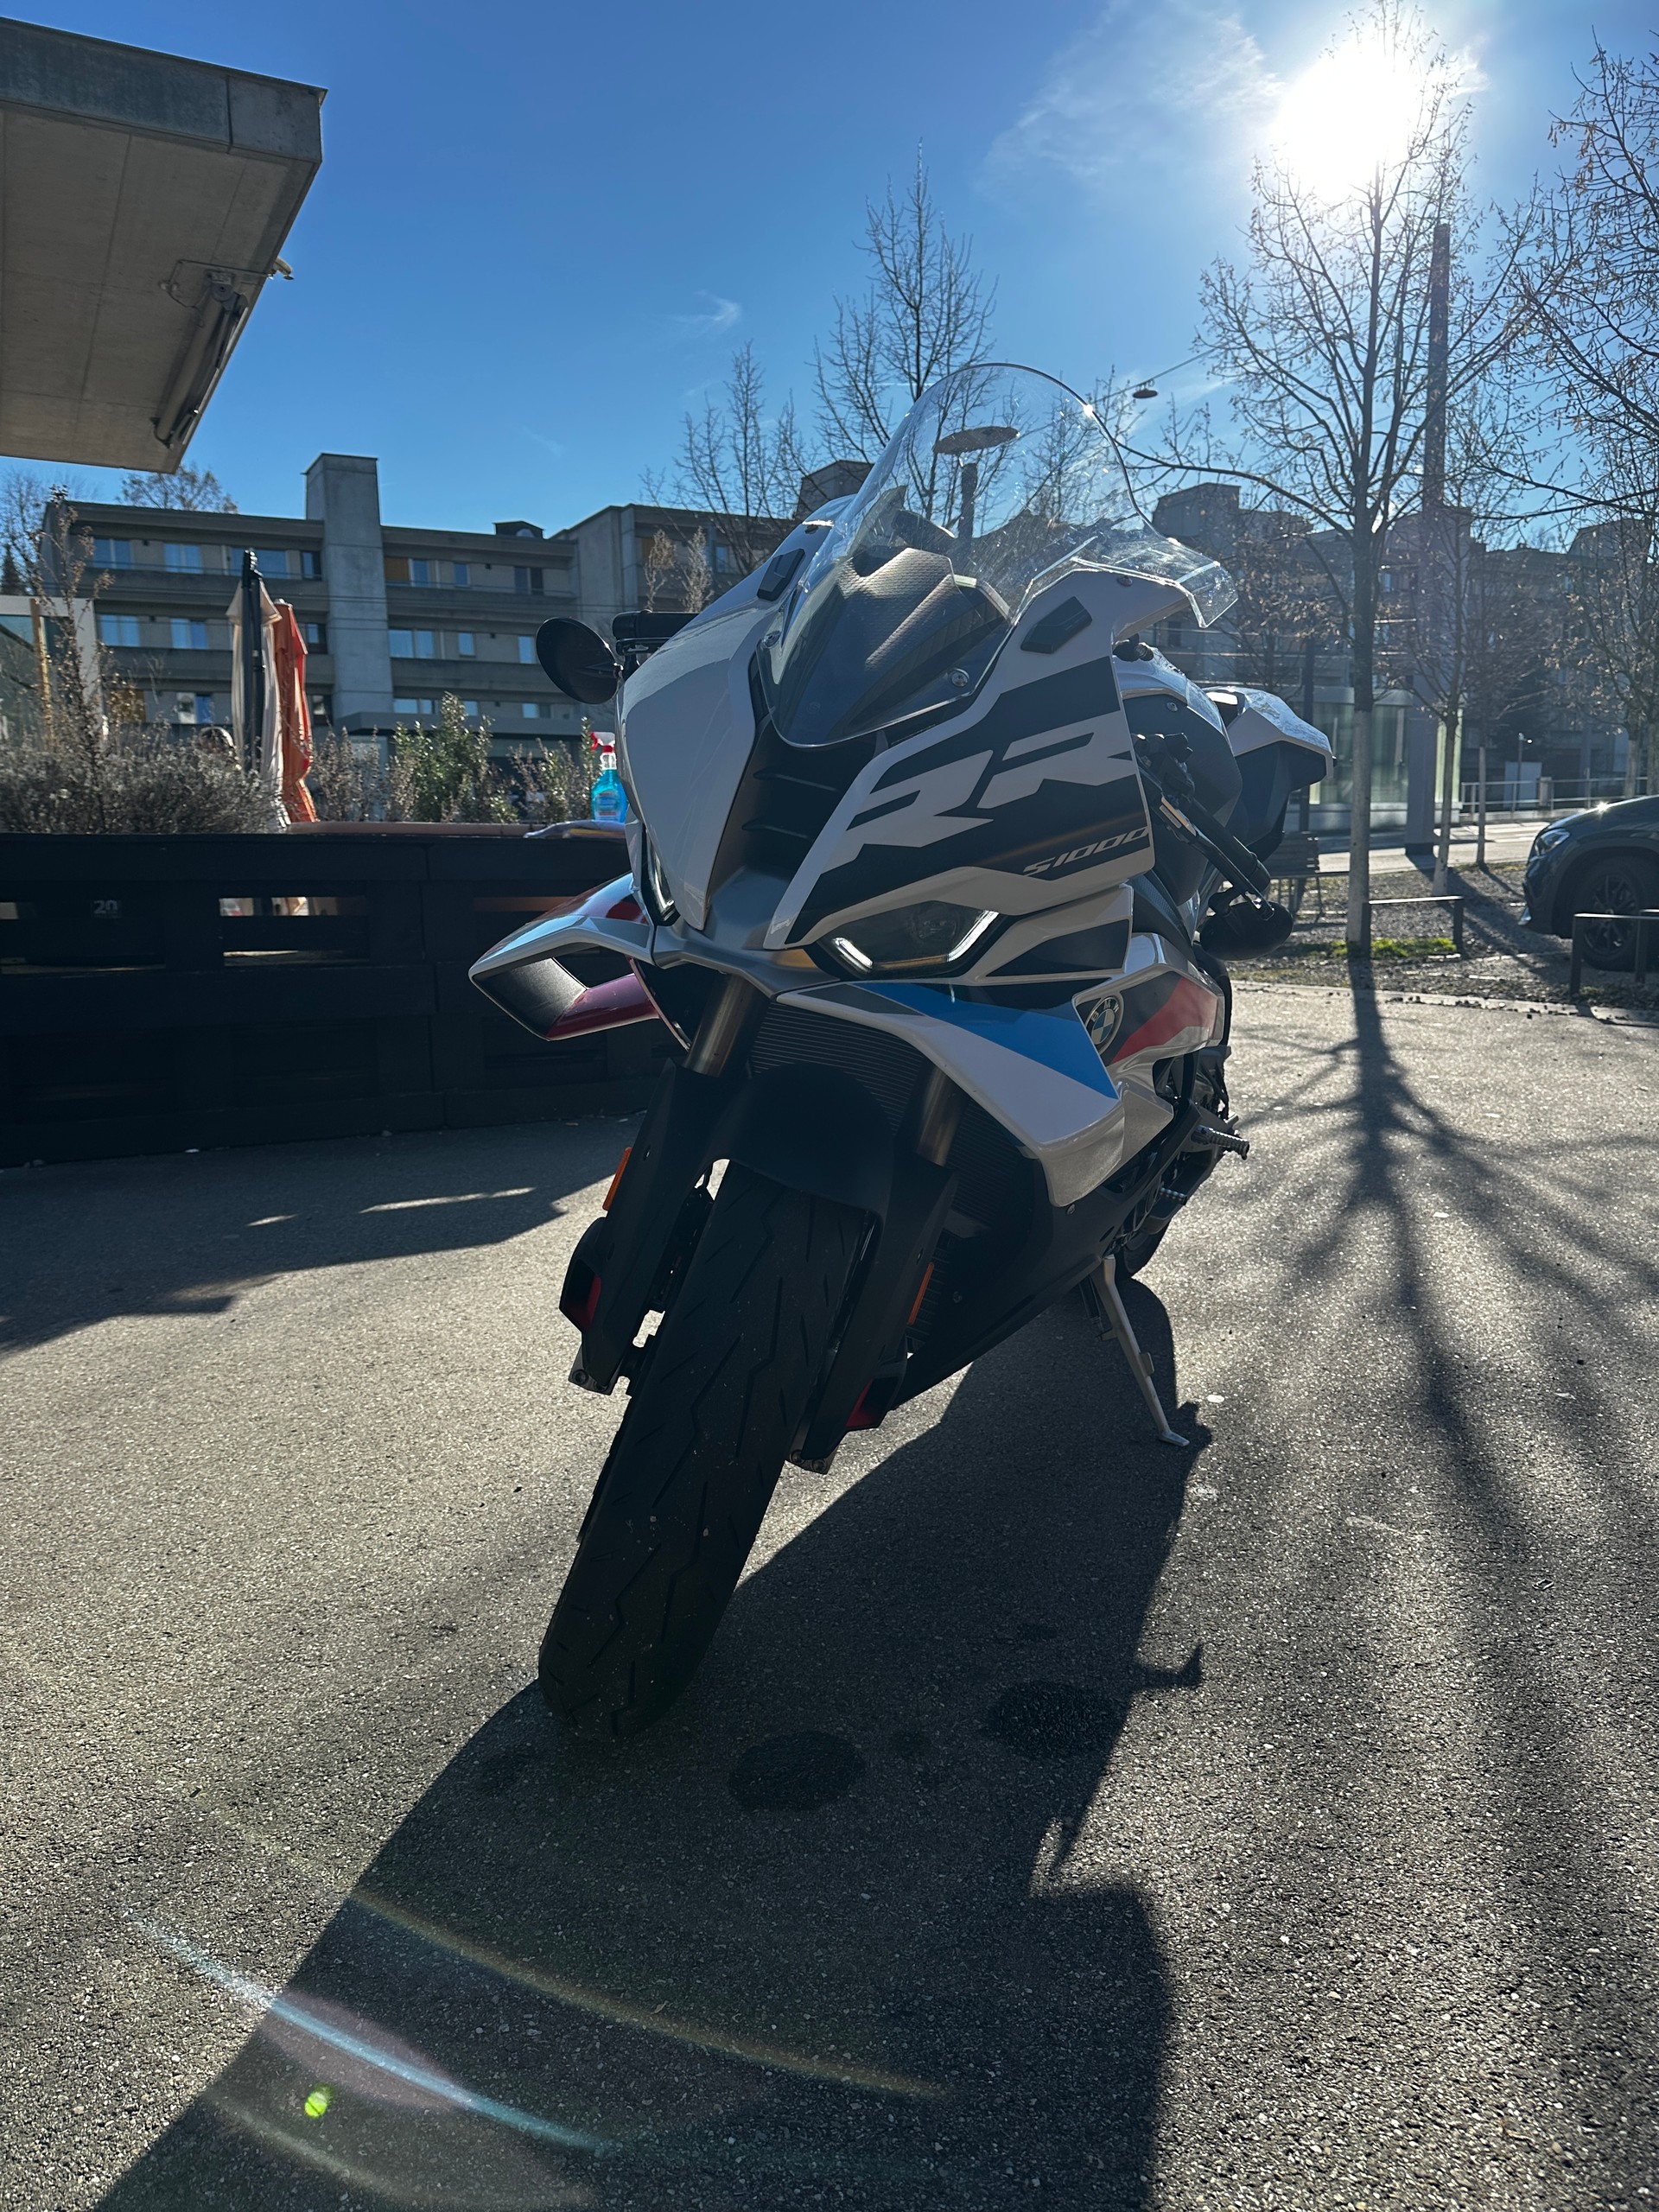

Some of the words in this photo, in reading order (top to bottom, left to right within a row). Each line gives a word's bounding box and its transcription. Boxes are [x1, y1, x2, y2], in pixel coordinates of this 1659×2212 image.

[819, 711, 1137, 874] RR
[1023, 827, 1149, 874] S1000
[1088, 999, 1119, 1022] BMW
